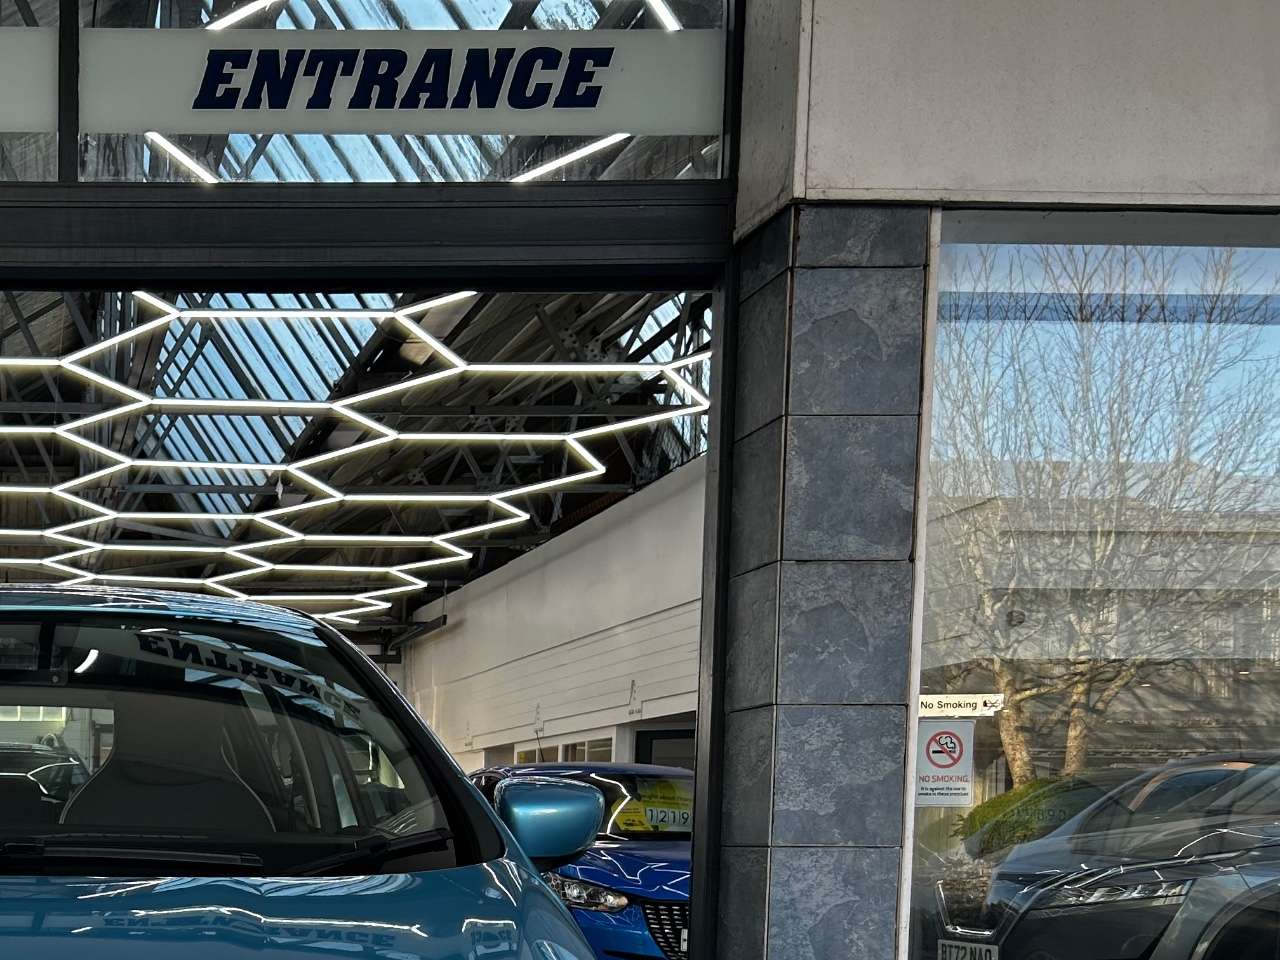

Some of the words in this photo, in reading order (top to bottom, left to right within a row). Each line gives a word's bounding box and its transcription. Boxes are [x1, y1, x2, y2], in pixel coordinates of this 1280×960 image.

[191, 47, 616, 110] ENTRANCE
[920, 701, 934, 709] No
[937, 700, 978, 711] Smoking
[919, 775, 931, 783] NO
[932, 775, 969, 783] SMOKING
